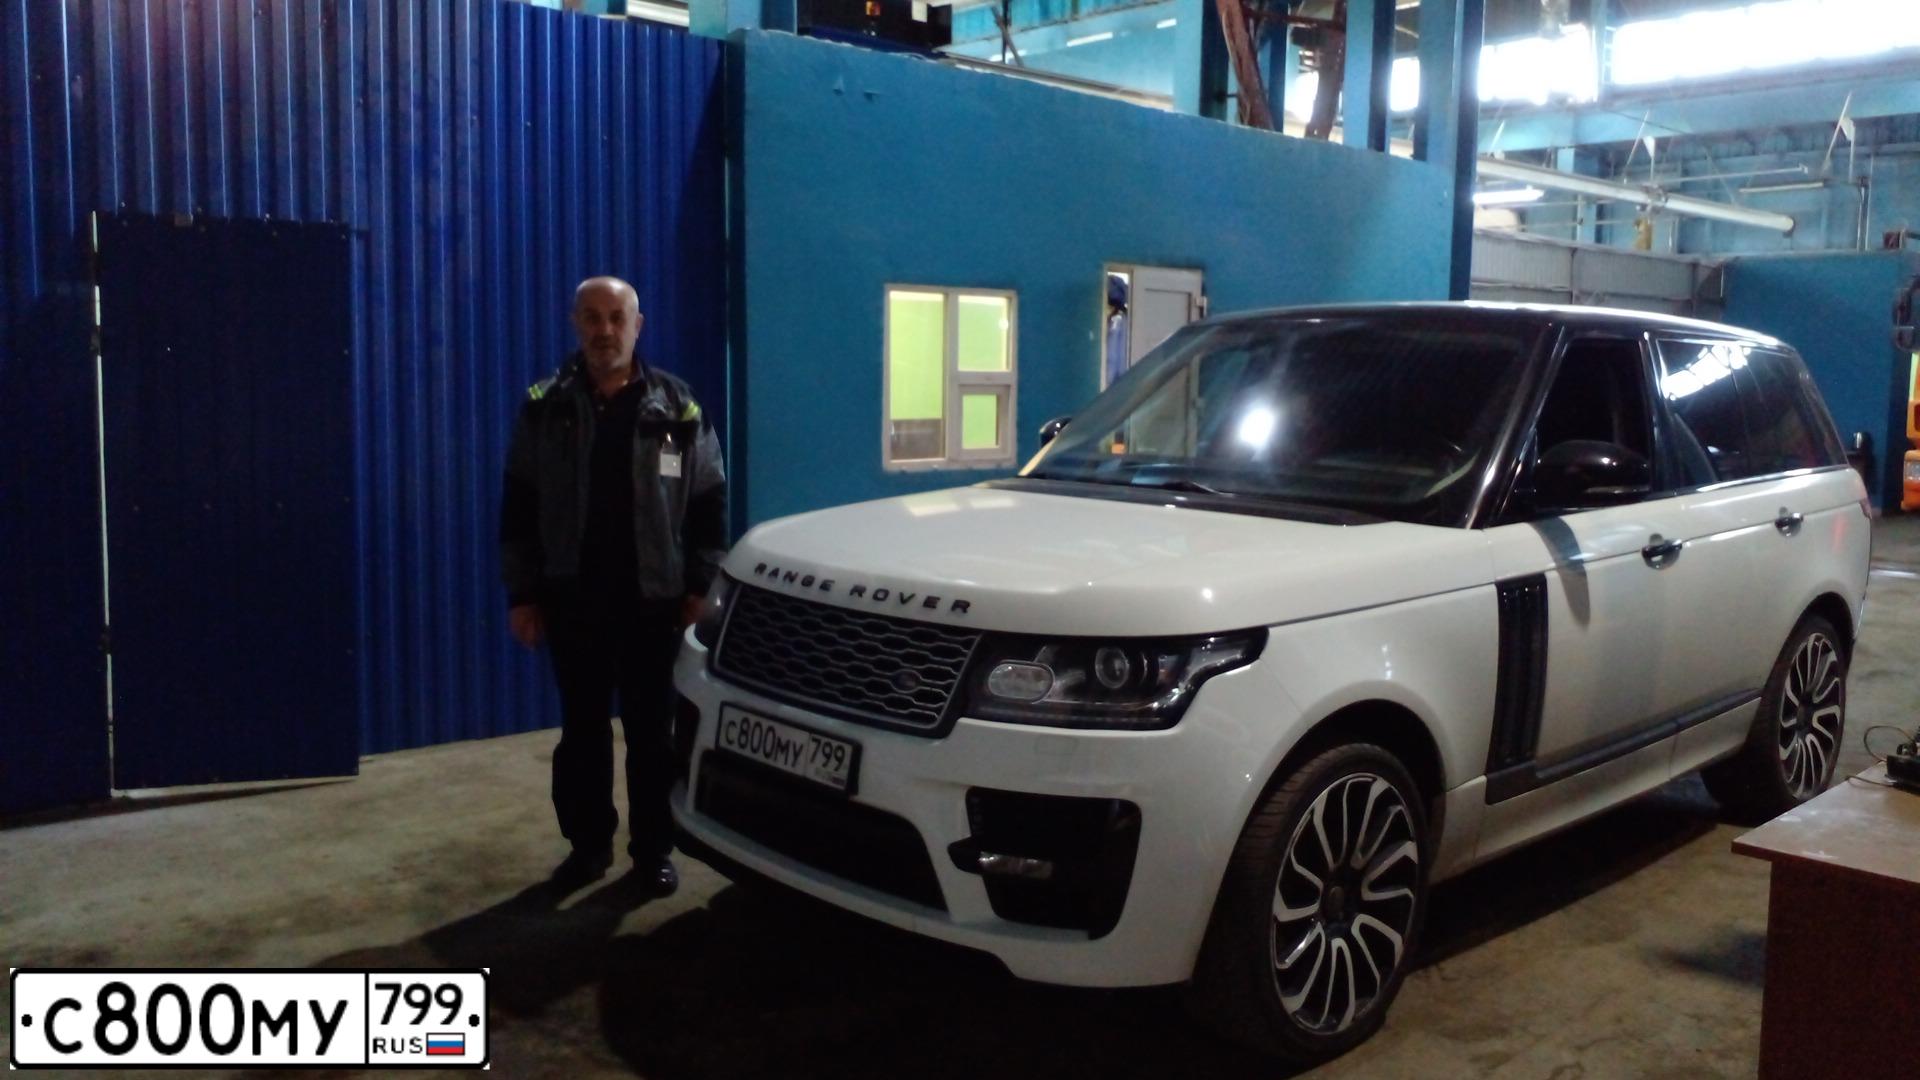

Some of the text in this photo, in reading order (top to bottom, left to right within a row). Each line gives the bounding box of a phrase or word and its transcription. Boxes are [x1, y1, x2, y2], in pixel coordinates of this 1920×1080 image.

[754, 562, 973, 614] RANGE ROVER
[810, 737, 847, 772] 799
